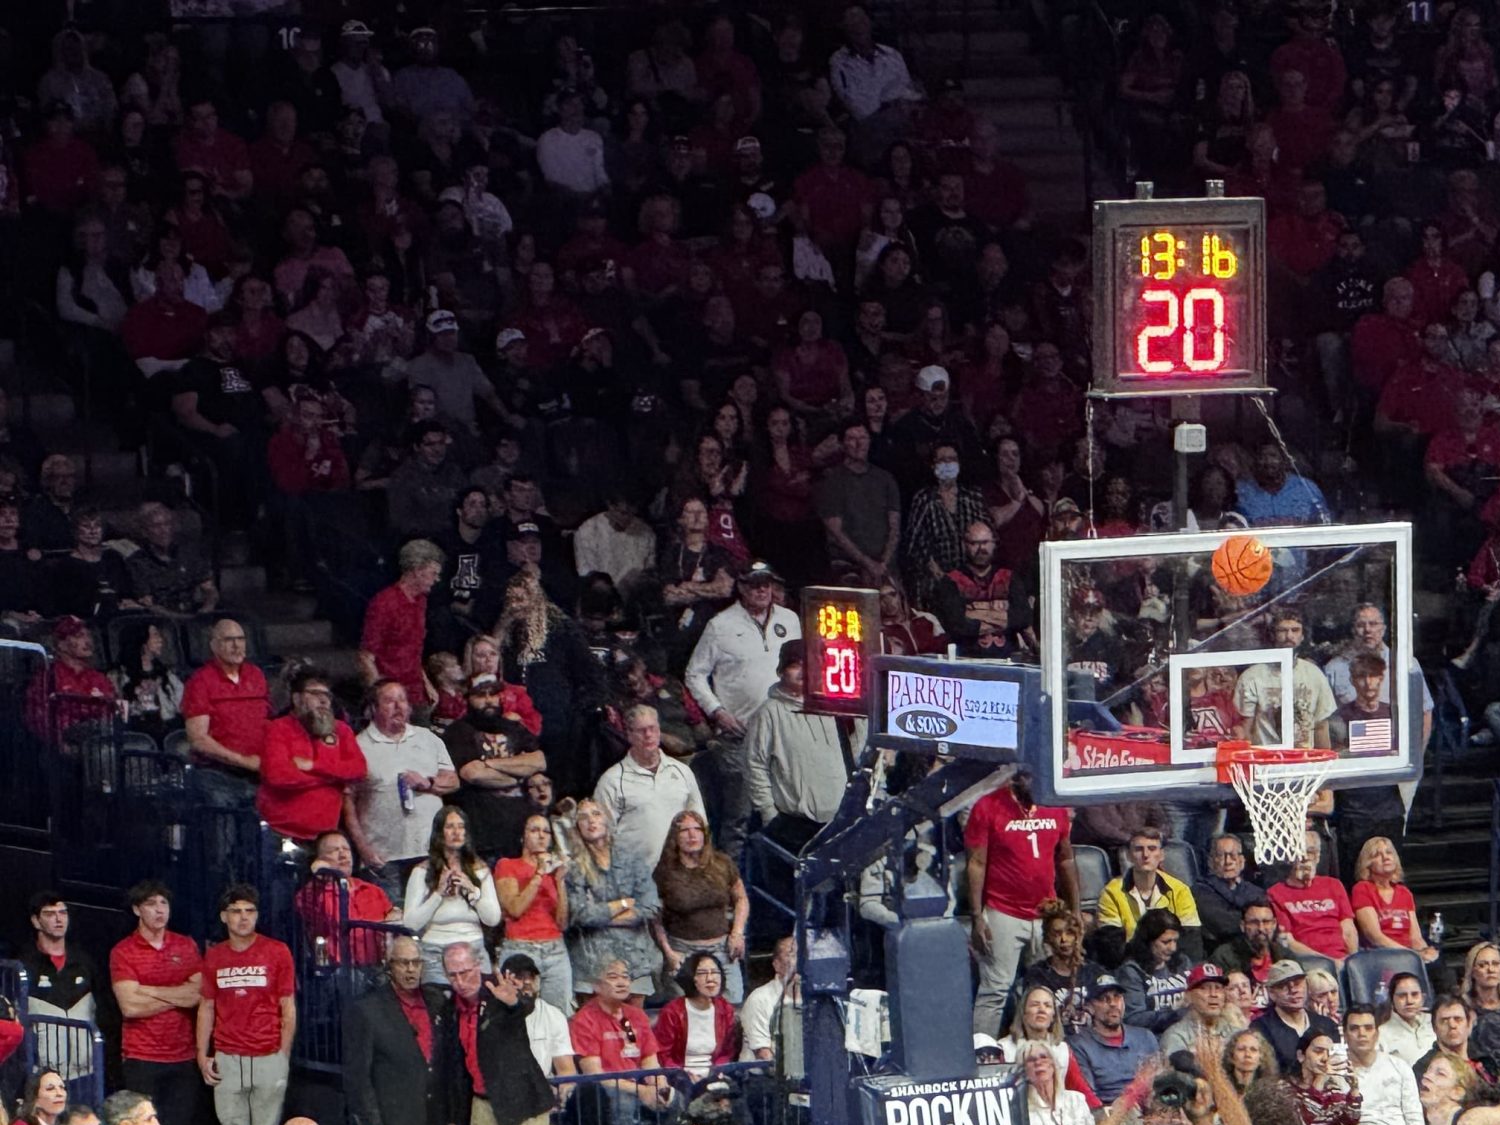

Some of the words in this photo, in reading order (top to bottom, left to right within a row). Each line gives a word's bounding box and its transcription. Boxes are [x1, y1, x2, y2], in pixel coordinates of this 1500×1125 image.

[1140, 232, 1238, 280] 13:16
[1136, 288, 1225, 372] 20
[825, 647, 856, 693] 20
[889, 674, 965, 721] PARKER
[905, 715, 920, 733] &
[916, 717, 948, 735] SONS
[1026, 832, 1040, 859] 1
[890, 1082, 958, 1098] SHAMROCK
